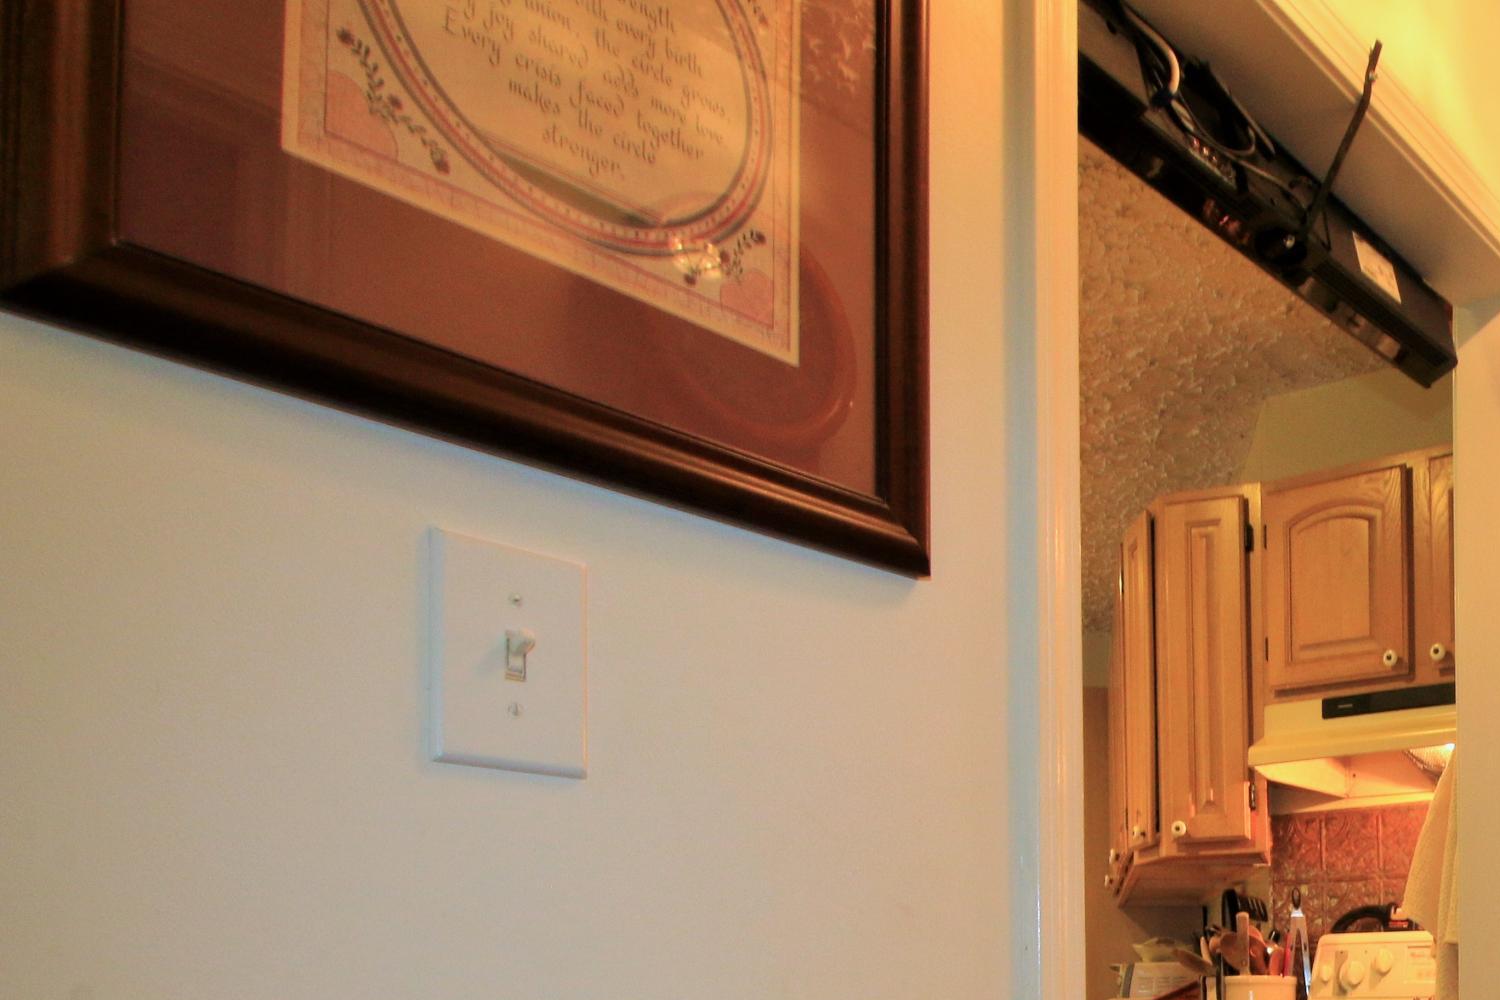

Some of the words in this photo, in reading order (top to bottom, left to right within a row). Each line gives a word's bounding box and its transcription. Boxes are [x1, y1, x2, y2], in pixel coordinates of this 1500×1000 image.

[575, 0, 609, 21] ith
[616, 17, 656, 60] every
[665, 36, 703, 78] birth
[595, 28, 620, 57] the
[631, 54, 673, 87] circle
[616, 0, 676, 33] ength
[442, 5, 501, 66] Every
[515, 52, 561, 88] crisis
[568, 79, 624, 117] faced
[637, 109, 704, 160] together
[482, 8, 515, 42] joy
[528, 25, 589, 69] shared
[602, 63, 640, 97] adds
[650, 95, 686, 125] more
[696, 115, 723, 146] love
[508, 78, 560, 114] makes
[578, 108, 603, 136] the
[612, 131, 656, 165] circle
